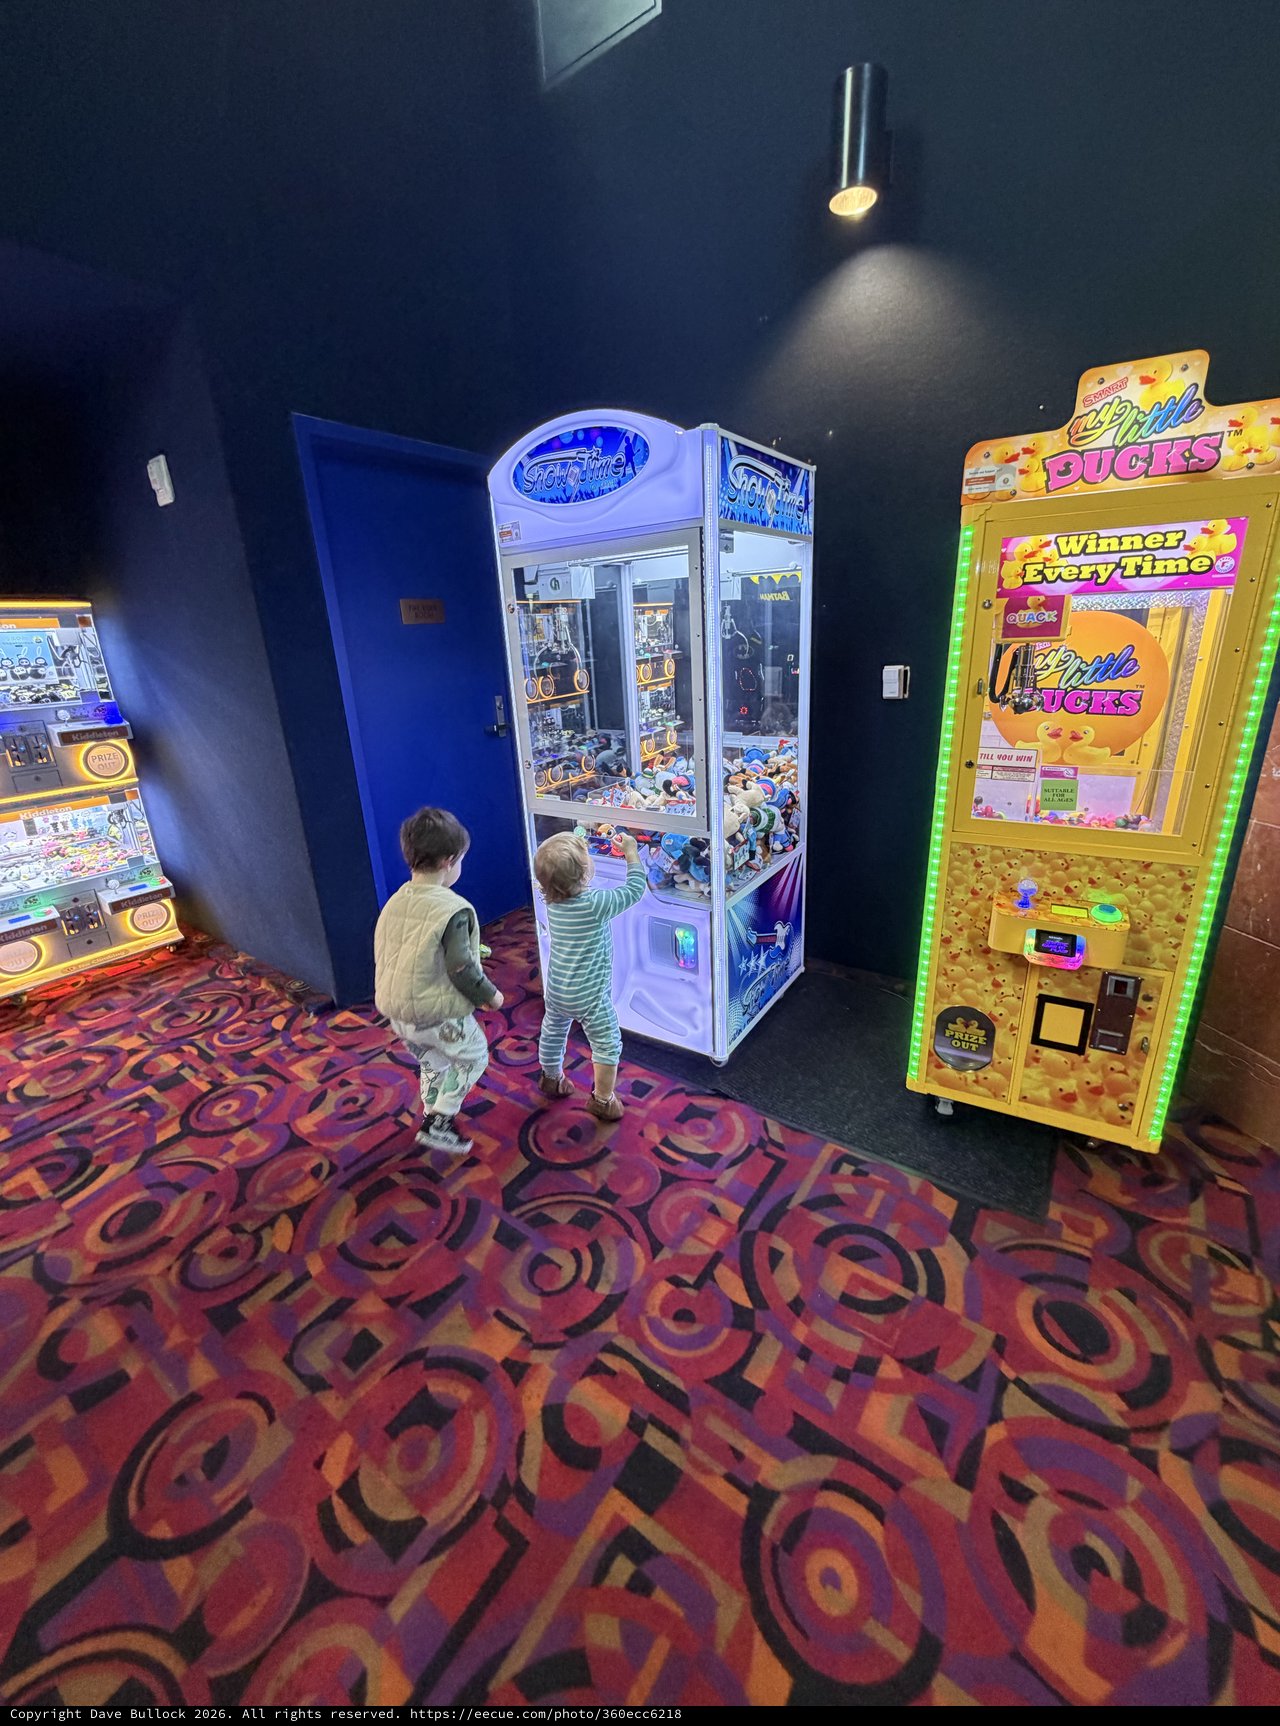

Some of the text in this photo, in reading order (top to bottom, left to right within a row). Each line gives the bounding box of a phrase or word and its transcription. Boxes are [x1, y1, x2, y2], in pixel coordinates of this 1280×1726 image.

[1083, 377, 1128, 407] SMART
[1067, 382, 1205, 447] my little
[1043, 431, 1224, 493] DUCKS
[1055, 530, 1185, 557] Winner
[1022, 560, 1118, 586] Every
[1119, 554, 1214, 578] Time
[1006, 610, 1058, 625] QUACK
[1059, 644, 1140, 690] little
[1024, 688, 1144, 716] UCKS
[91, 752, 119, 763] PRIZE
[97, 762, 116, 771] OUT
[979, 753, 1033, 763] TILL YOU WIN
[19, 806, 72, 820] Kiddleton
[945, 1029, 987, 1045] PRIZE
[951, 1039, 979, 1052] OUT
